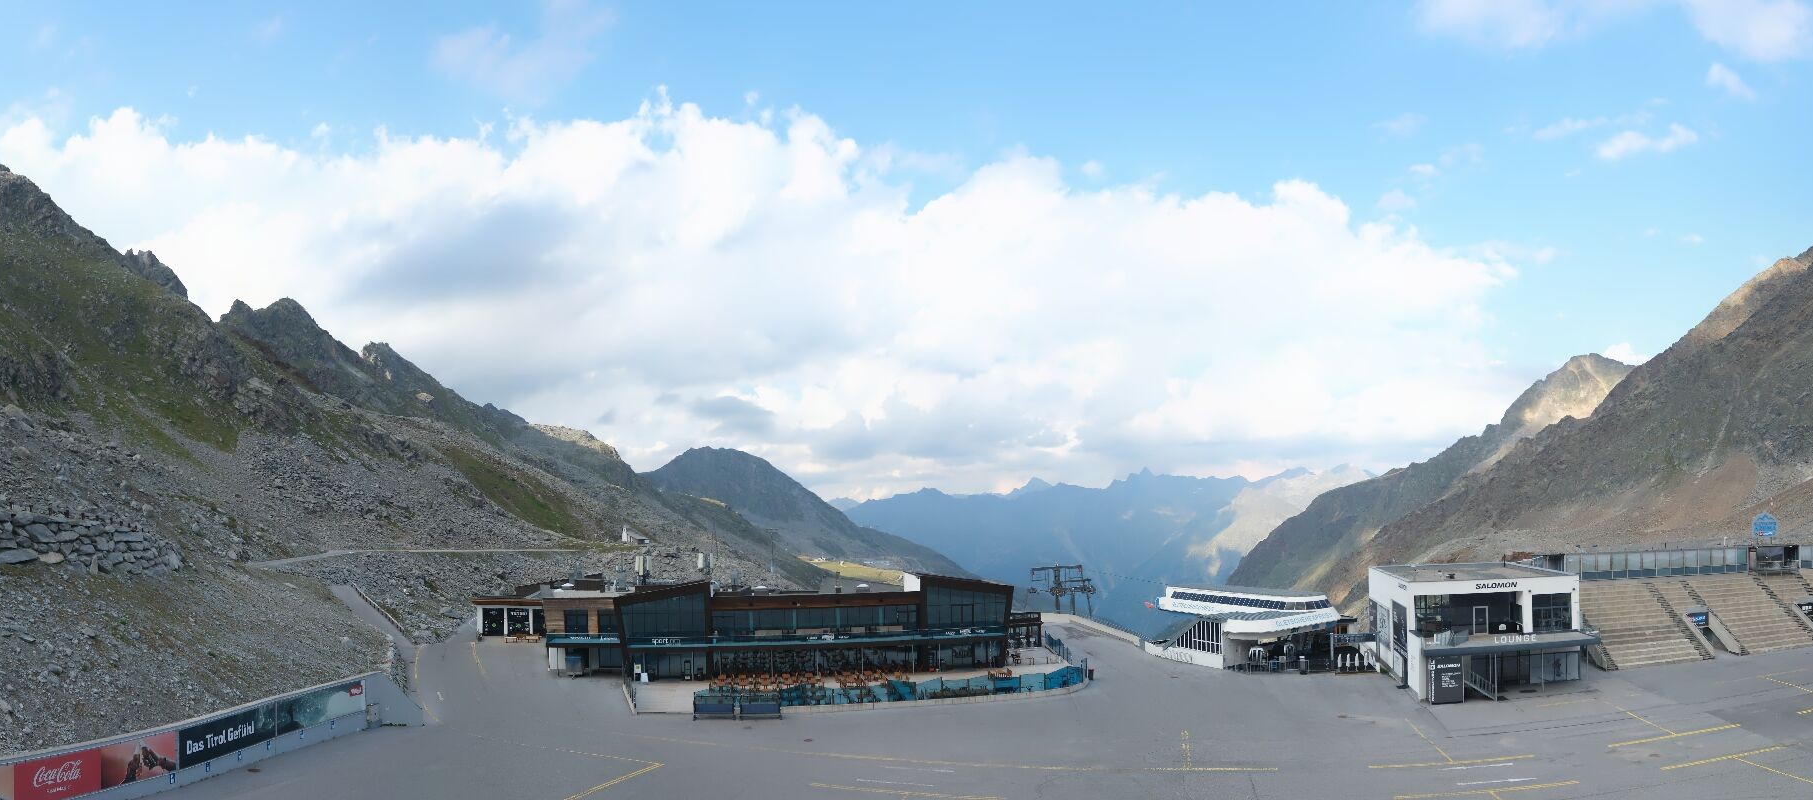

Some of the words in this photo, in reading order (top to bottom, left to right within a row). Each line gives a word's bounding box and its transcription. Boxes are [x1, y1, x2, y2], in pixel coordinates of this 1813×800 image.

[1475, 581, 1518, 590] SALOMON
[1494, 633, 1537, 644] LOUNGE
[186, 739, 205, 755] Das
[205, 729, 227, 749] Tirol
[227, 720, 255, 742] Gefühl
